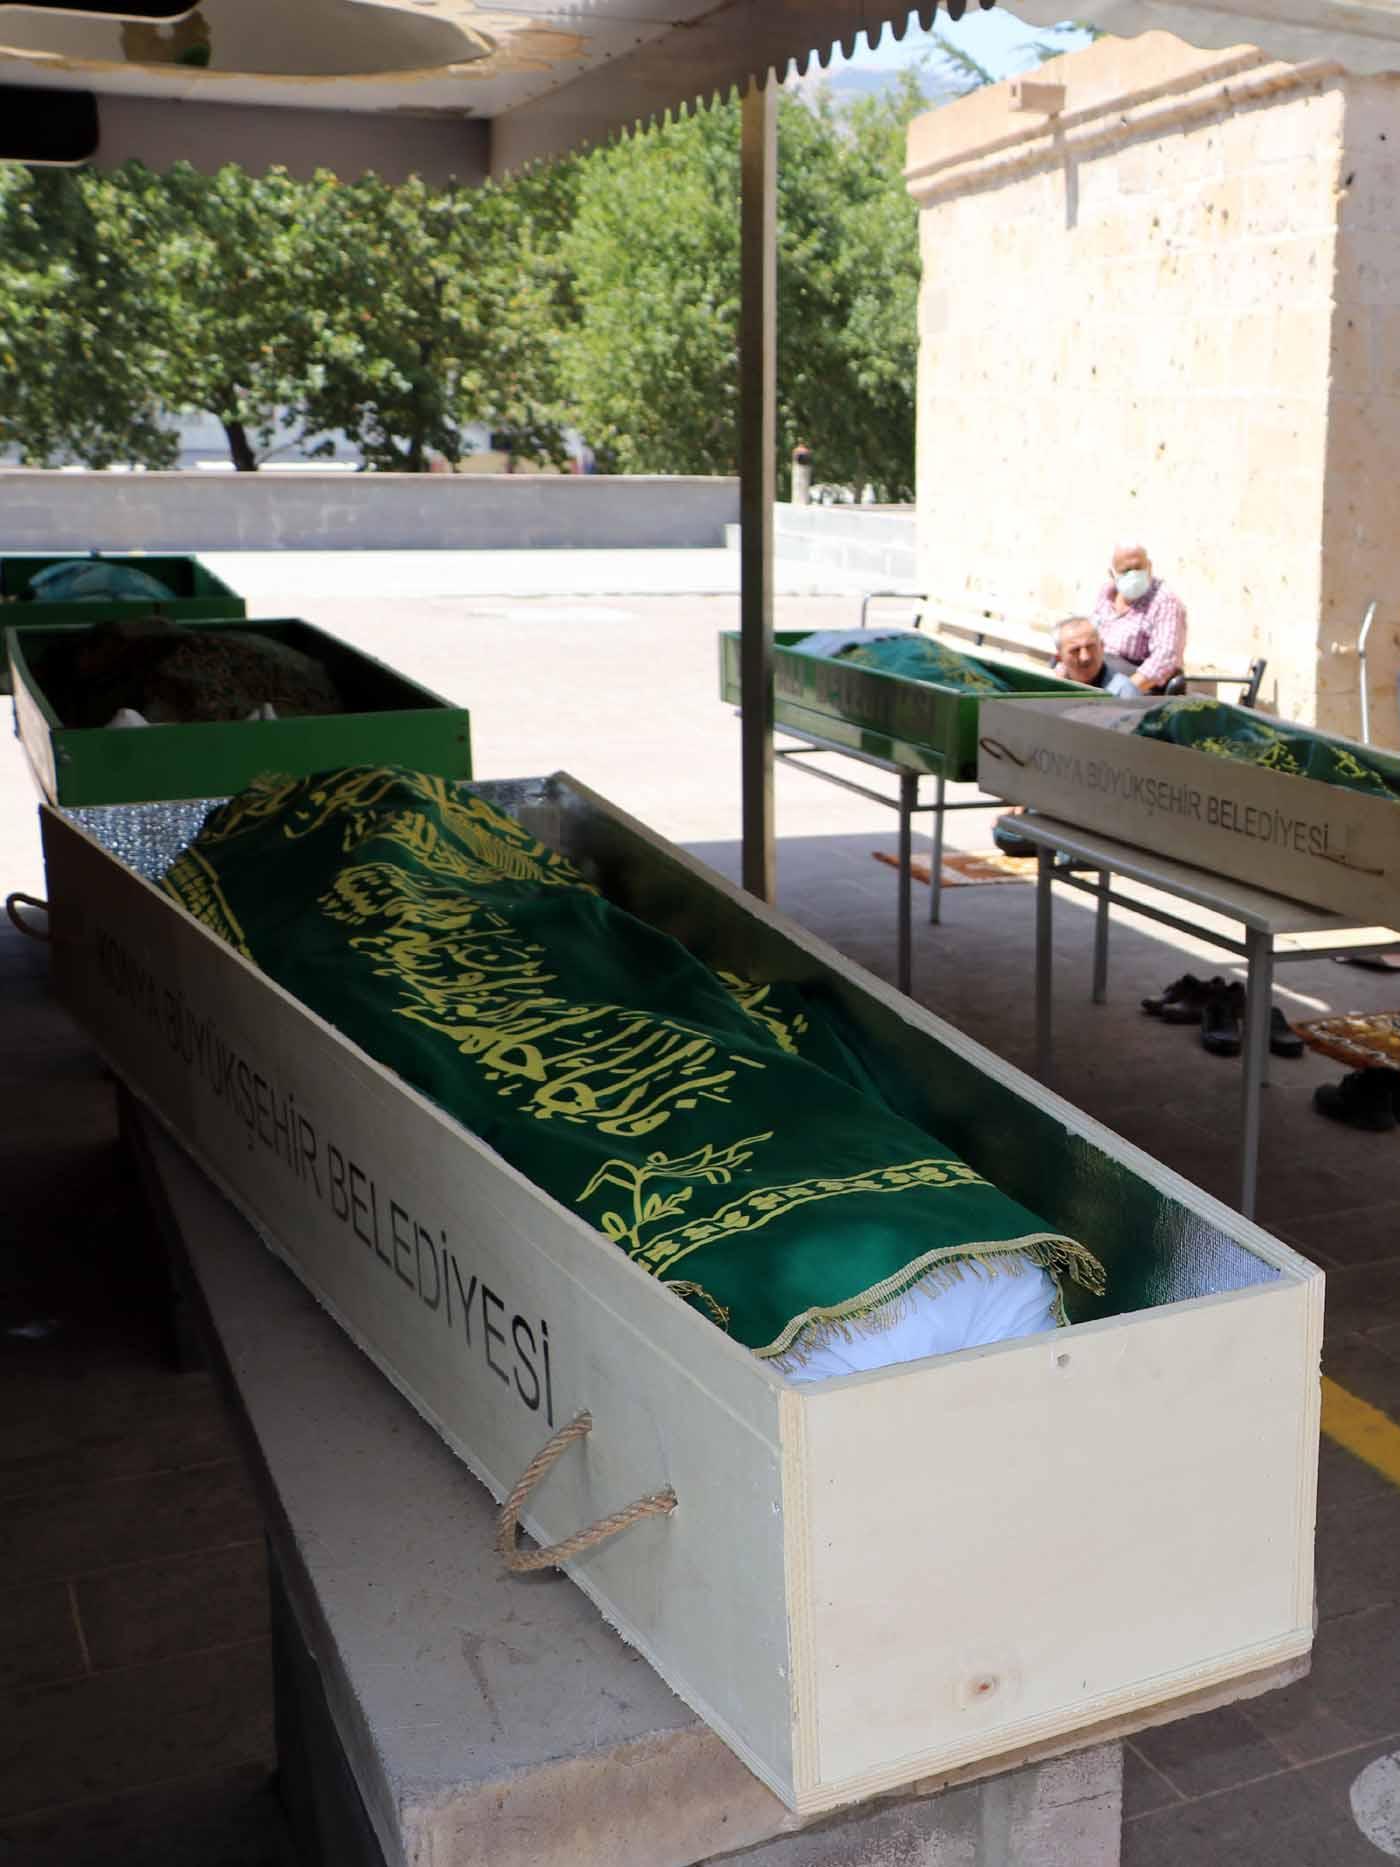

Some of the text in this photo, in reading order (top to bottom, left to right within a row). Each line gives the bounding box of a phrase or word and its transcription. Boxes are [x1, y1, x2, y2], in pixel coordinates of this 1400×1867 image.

[1029, 747, 1329, 853] KONYA BÜYÜKŞEHİR BELEDİYESİ
[163, 987, 322, 1200] BÜYÜKŞEHİR
[326, 1142, 555, 1428] BELEDİYESİ
